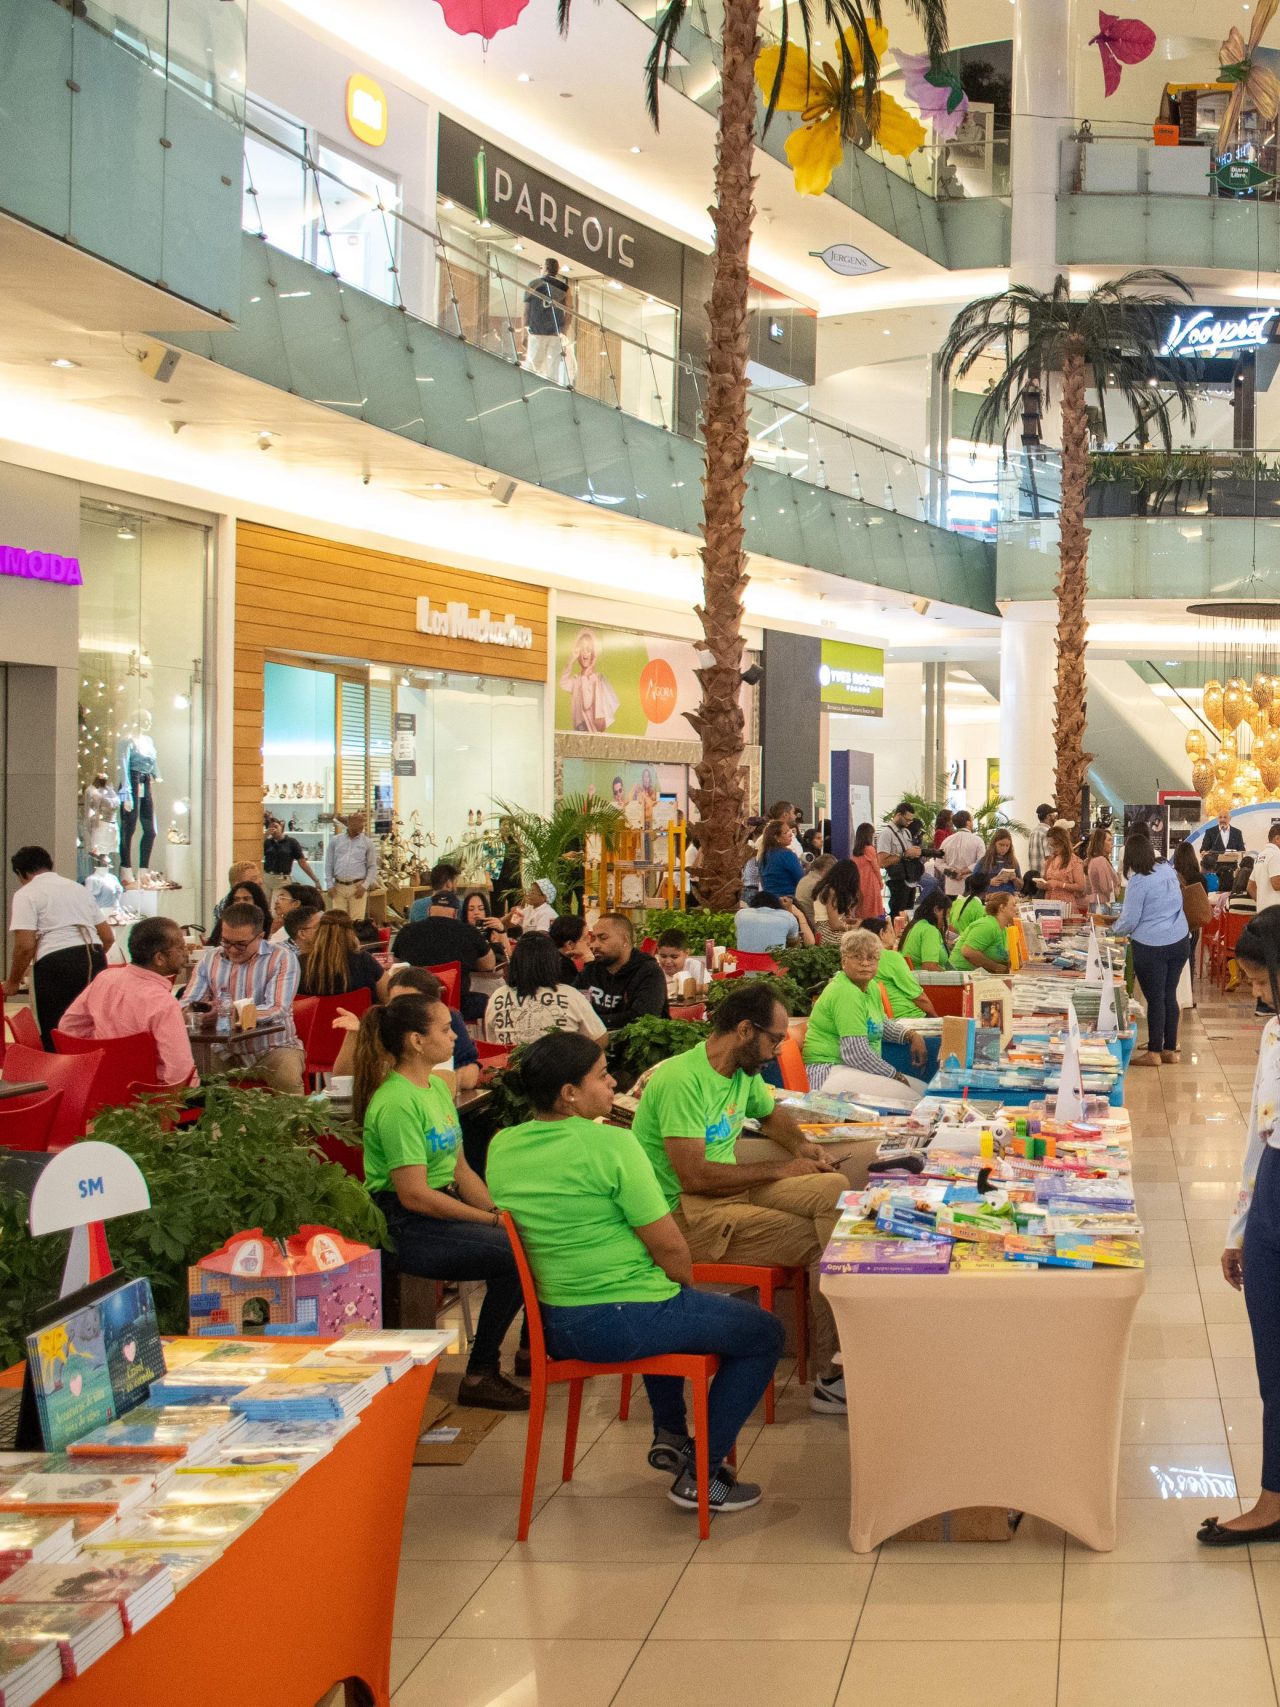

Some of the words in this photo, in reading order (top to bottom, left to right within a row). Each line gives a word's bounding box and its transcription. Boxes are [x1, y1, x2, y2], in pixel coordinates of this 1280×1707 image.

[495, 167, 635, 268] PARFOIS
[830, 250, 868, 266] JERGENS
[416, 595, 448, 636] Los
[78, 1176, 104, 1199] SM
